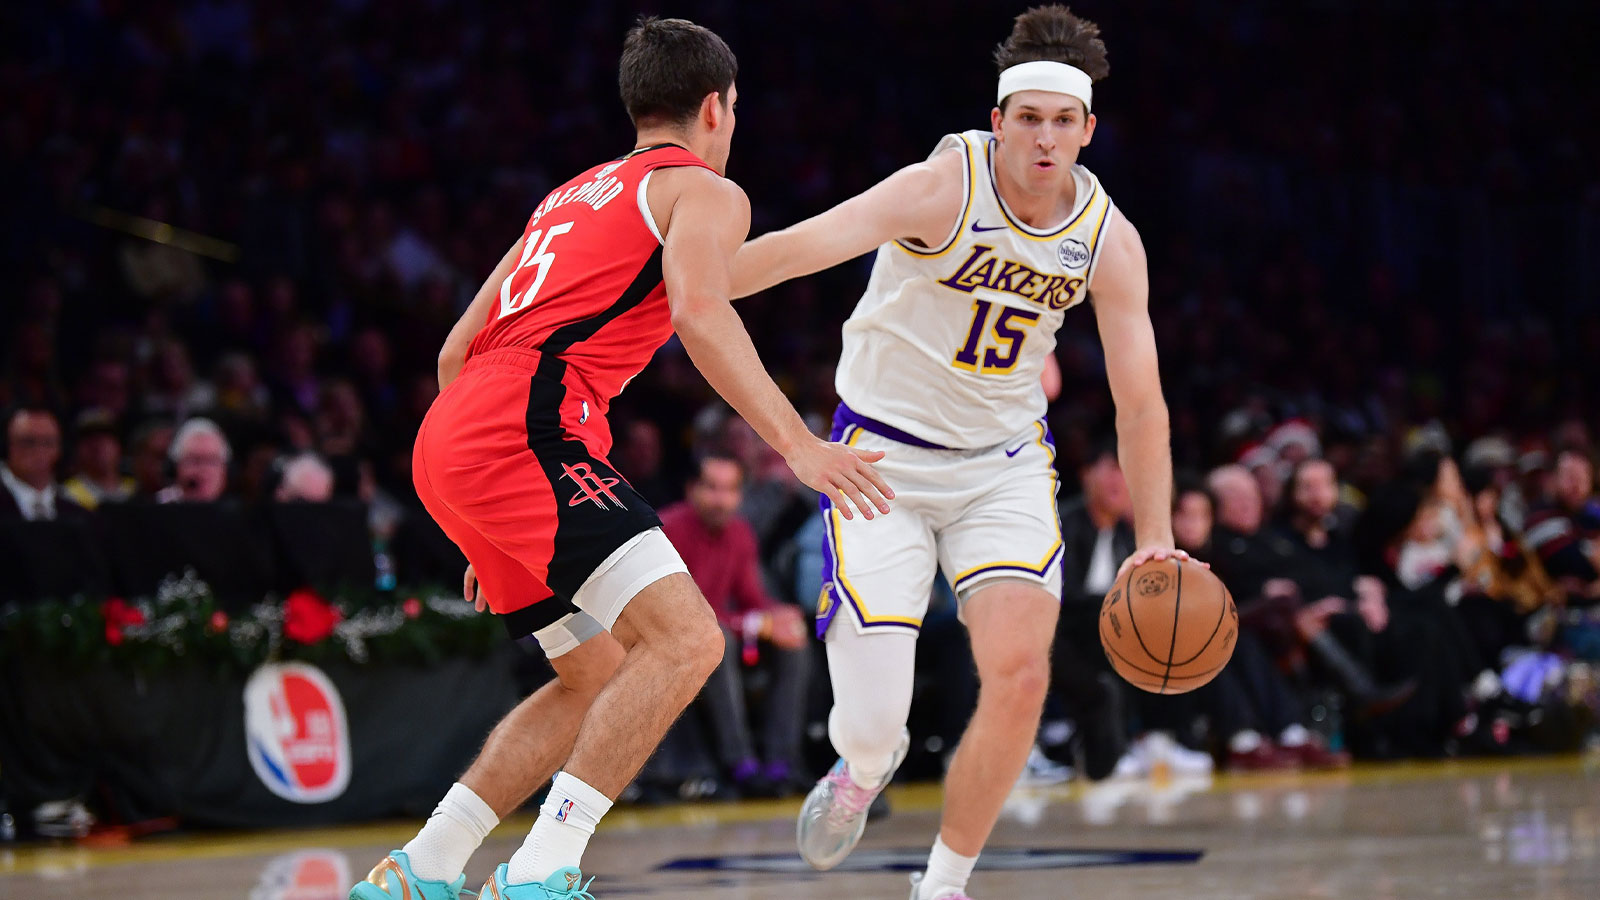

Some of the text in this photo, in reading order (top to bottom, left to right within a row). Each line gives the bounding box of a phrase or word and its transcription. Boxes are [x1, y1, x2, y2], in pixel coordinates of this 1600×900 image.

[532, 175, 624, 227] SHEPPARD
[497, 221, 575, 320] 15
[937, 245, 1084, 309] LAKERS
[952, 298, 1042, 375] 15
